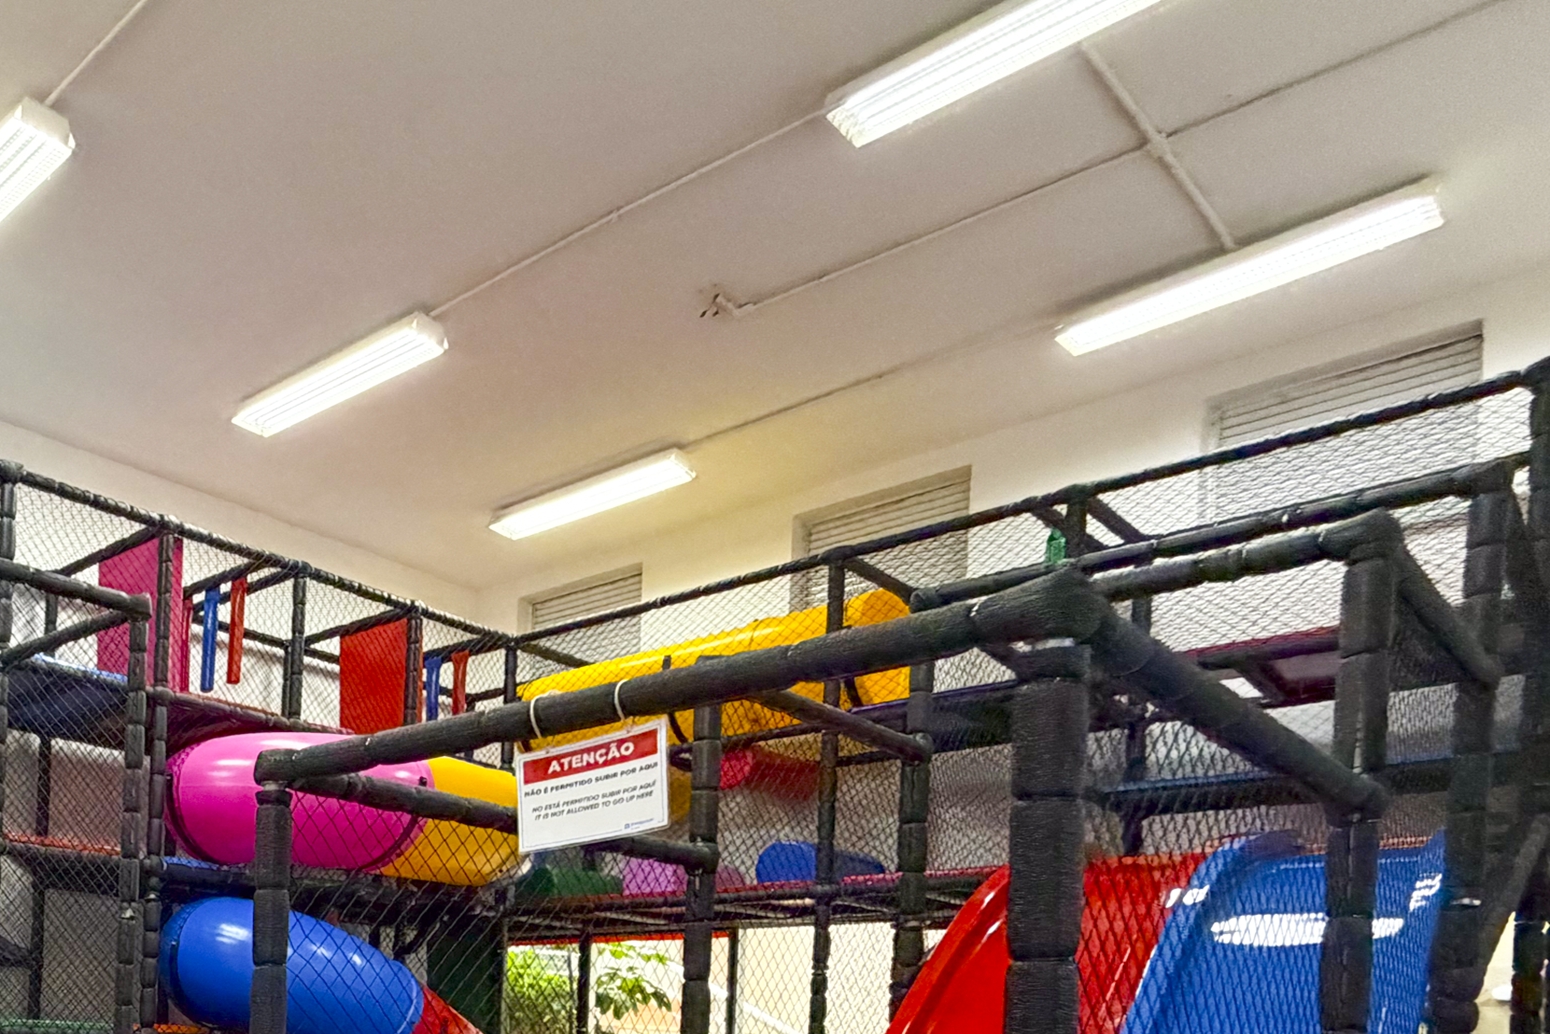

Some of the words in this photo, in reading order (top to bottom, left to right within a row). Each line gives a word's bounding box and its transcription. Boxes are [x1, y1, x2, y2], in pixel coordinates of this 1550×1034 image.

[547, 741, 635, 775] ATENÇÃO
[524, 788, 542, 798] NÃO
[543, 786, 549, 794] É
[550, 778, 593, 793] PERMITIDO
[594, 771, 618, 783] SUBIR
[620, 767, 637, 777] POR
[639, 761, 658, 772] AQUI
[532, 805, 543, 813] NO
[544, 801, 560, 811] ESTÁ
[562, 794, 600, 808] PERMITIDO
[601, 789, 621, 799] SUBIR
[622, 785, 638, 794] POR
[535, 813, 542, 821] IT
[542, 812, 549, 820] IS
[550, 809, 565, 818] NOT
[566, 803, 600, 815] ALLOWED
[601, 800, 611, 808] TO
[612, 797, 624, 806] GO
[625, 794, 636, 803] UP
[636, 790, 654, 800] HERE
